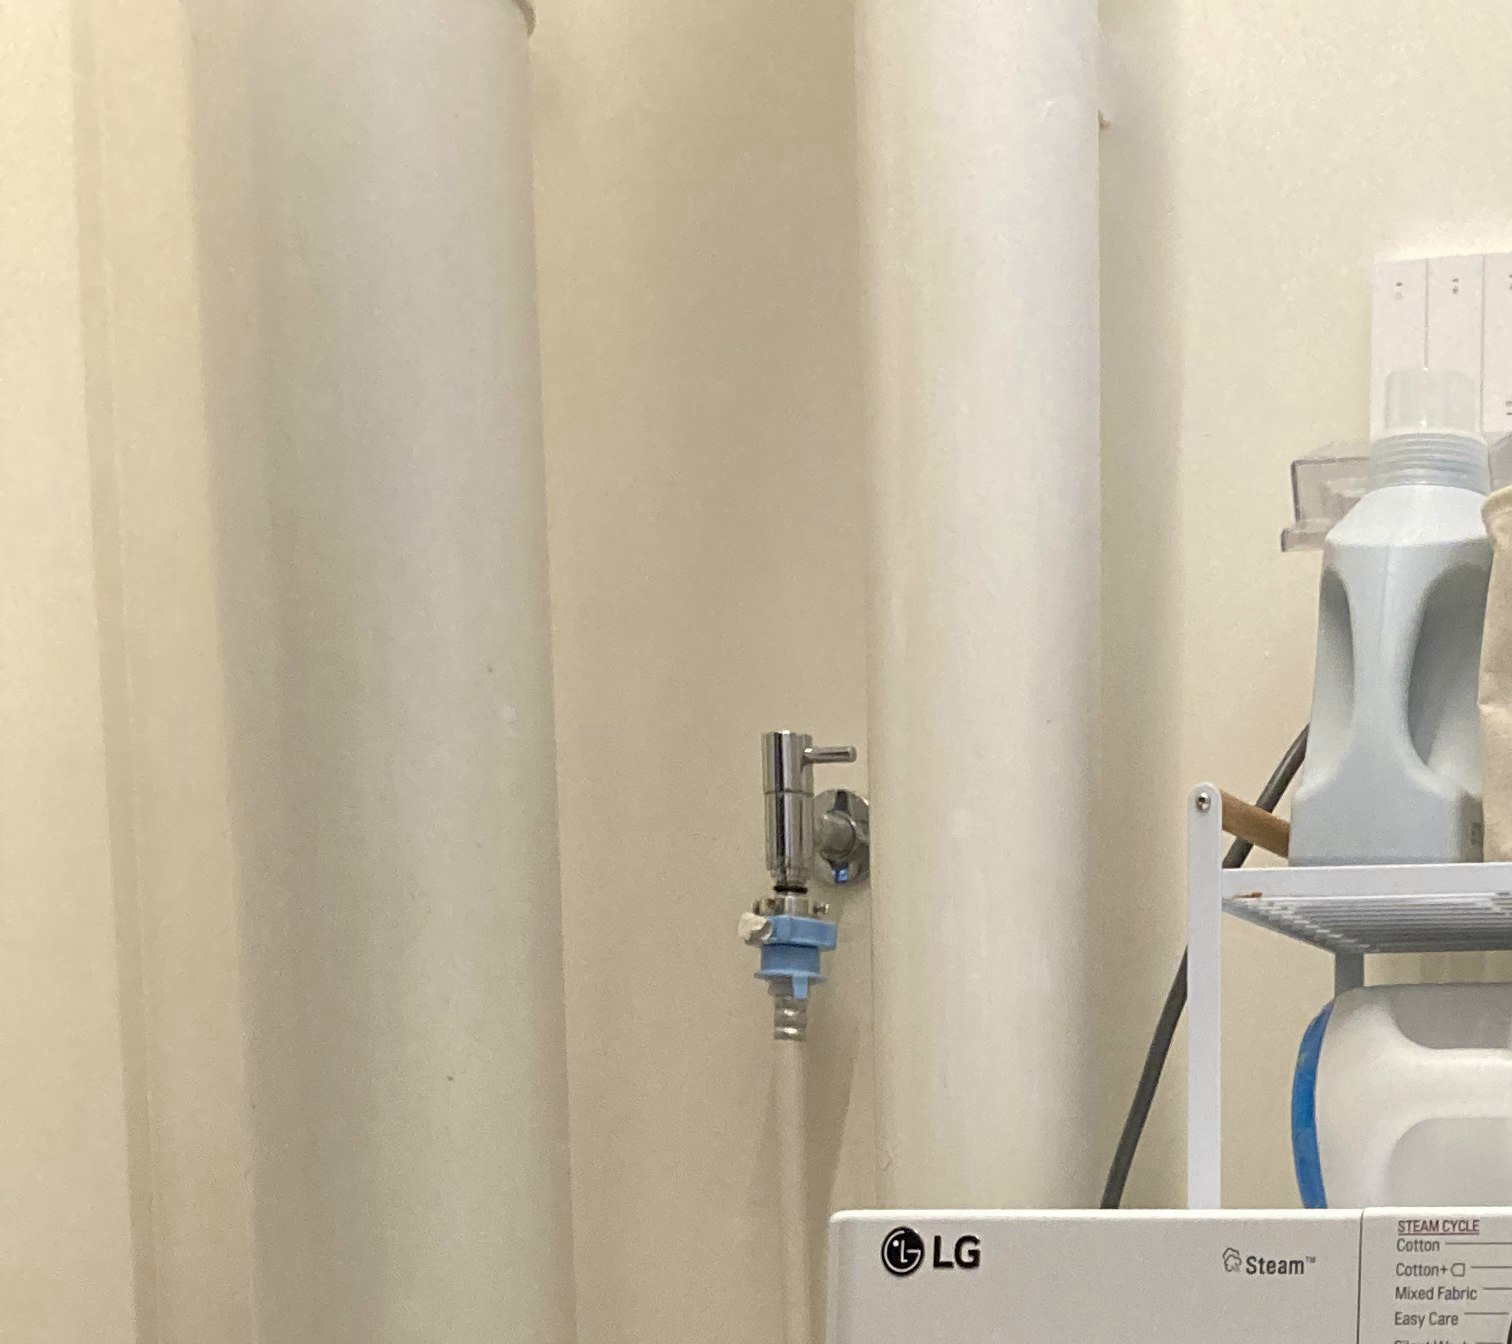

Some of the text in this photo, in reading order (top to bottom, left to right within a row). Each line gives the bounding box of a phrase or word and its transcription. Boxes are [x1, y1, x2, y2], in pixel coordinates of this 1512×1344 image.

[1398, 1219, 1480, 1233] STEAM CYCLE
[933, 1235, 981, 1269] LG
[1396, 1237, 1440, 1252] Cotton
[1395, 1286, 1477, 1301] Mixed Fabric
[1394, 1311, 1458, 1329] Easy Care
